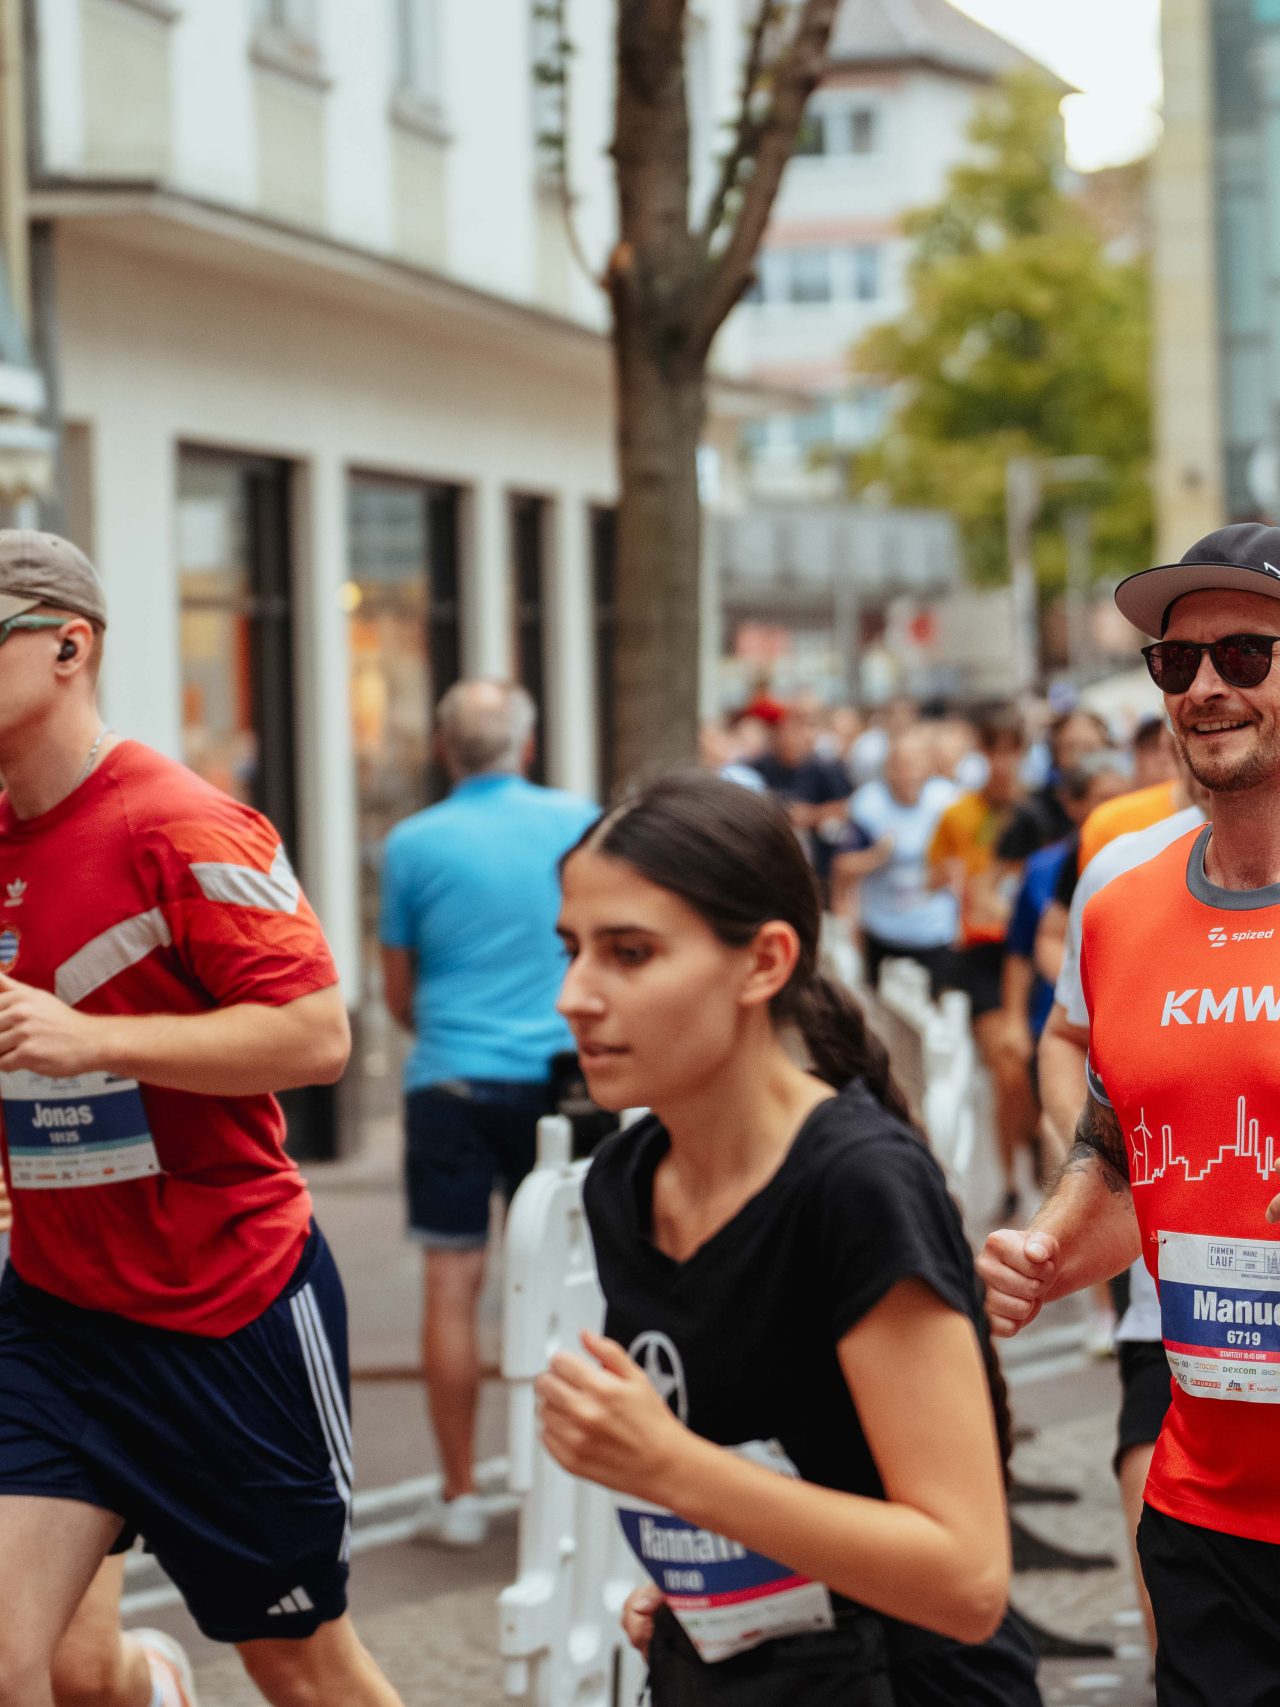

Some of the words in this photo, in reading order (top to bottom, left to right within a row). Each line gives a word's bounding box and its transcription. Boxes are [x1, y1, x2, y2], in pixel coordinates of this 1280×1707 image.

[1231, 928, 1274, 942] spized
[31, 1102, 94, 1128] Jonas
[1210, 1246, 1234, 1255] FIRMEN
[1210, 1255, 1234, 1267] LAUF
[1226, 1330, 1261, 1346] 6719
